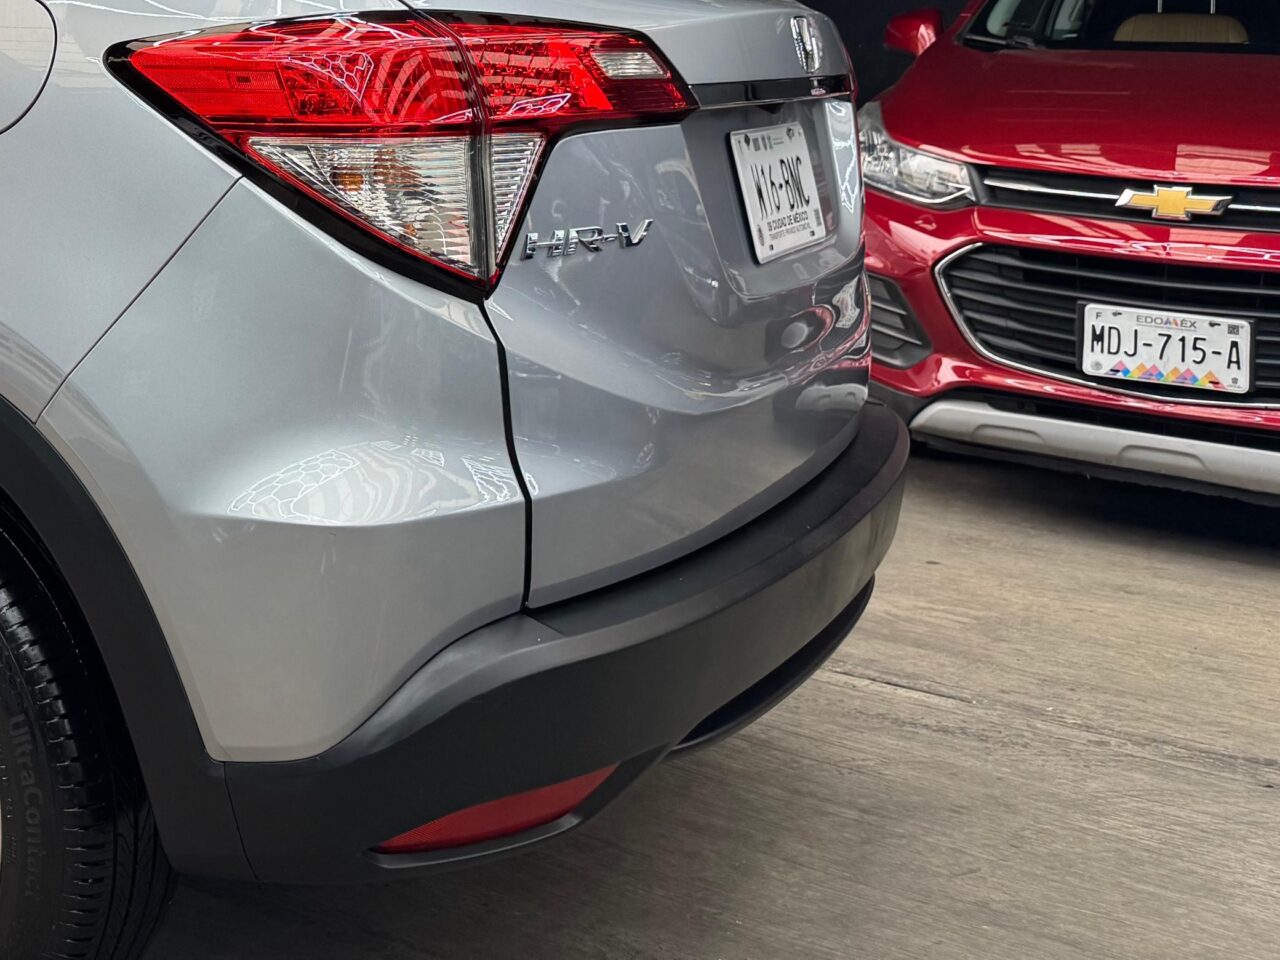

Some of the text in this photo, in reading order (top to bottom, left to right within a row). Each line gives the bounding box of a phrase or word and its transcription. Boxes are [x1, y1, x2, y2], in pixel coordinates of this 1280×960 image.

[750, 155, 810, 221] W16-BNC
[521, 219, 653, 259] HR-V
[1090, 324, 1241, 371] MDJ-715-A
